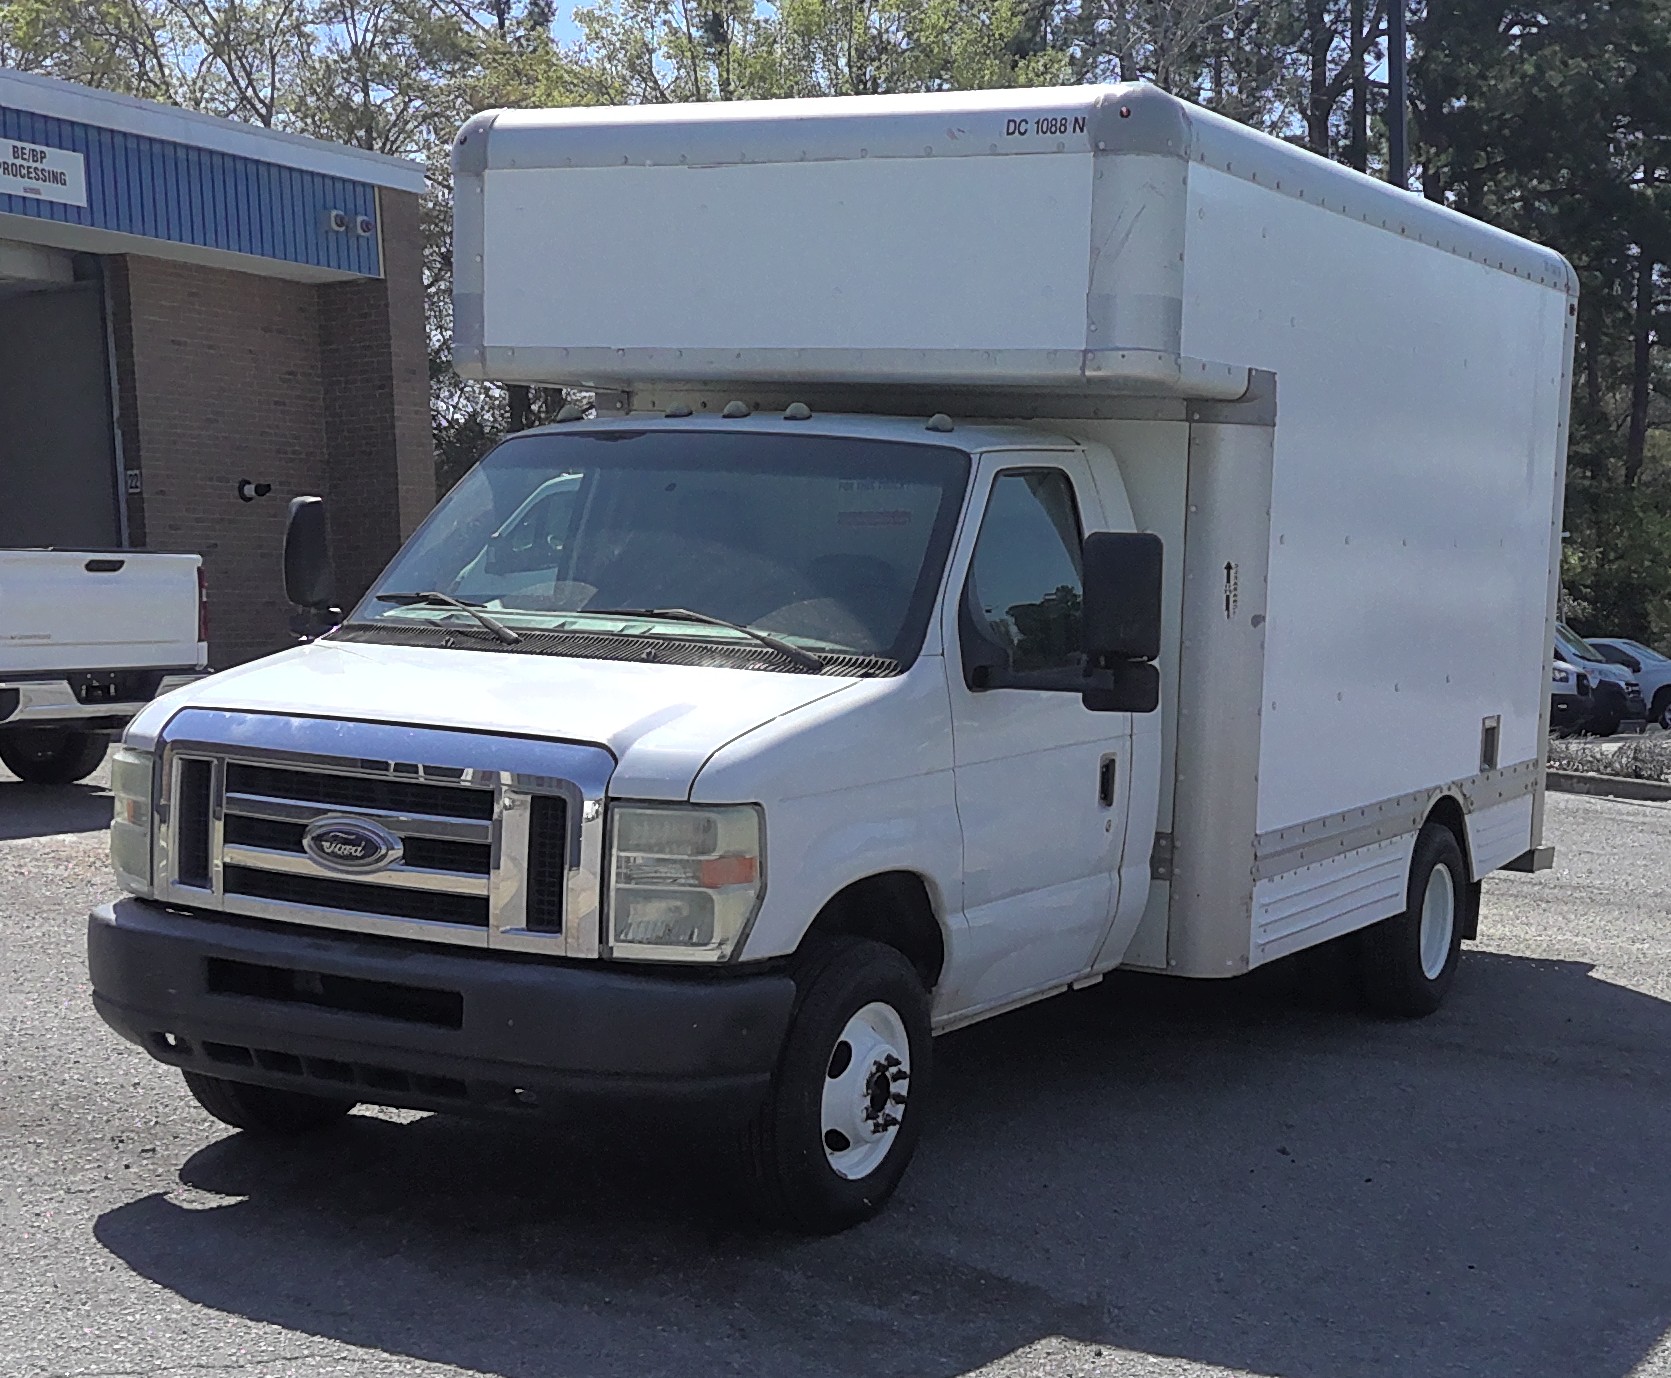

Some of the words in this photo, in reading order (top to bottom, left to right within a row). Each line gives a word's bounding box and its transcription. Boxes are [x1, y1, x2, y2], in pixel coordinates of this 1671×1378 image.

[1006, 118, 1029, 136] DC
[1034, 117, 1068, 135] 1088
[1072, 116, 1087, 134] N
[12, 144, 47, 164] BE/BP
[0, 160, 67, 187] ROCESSING
[321, 832, 366, 857] Ford
